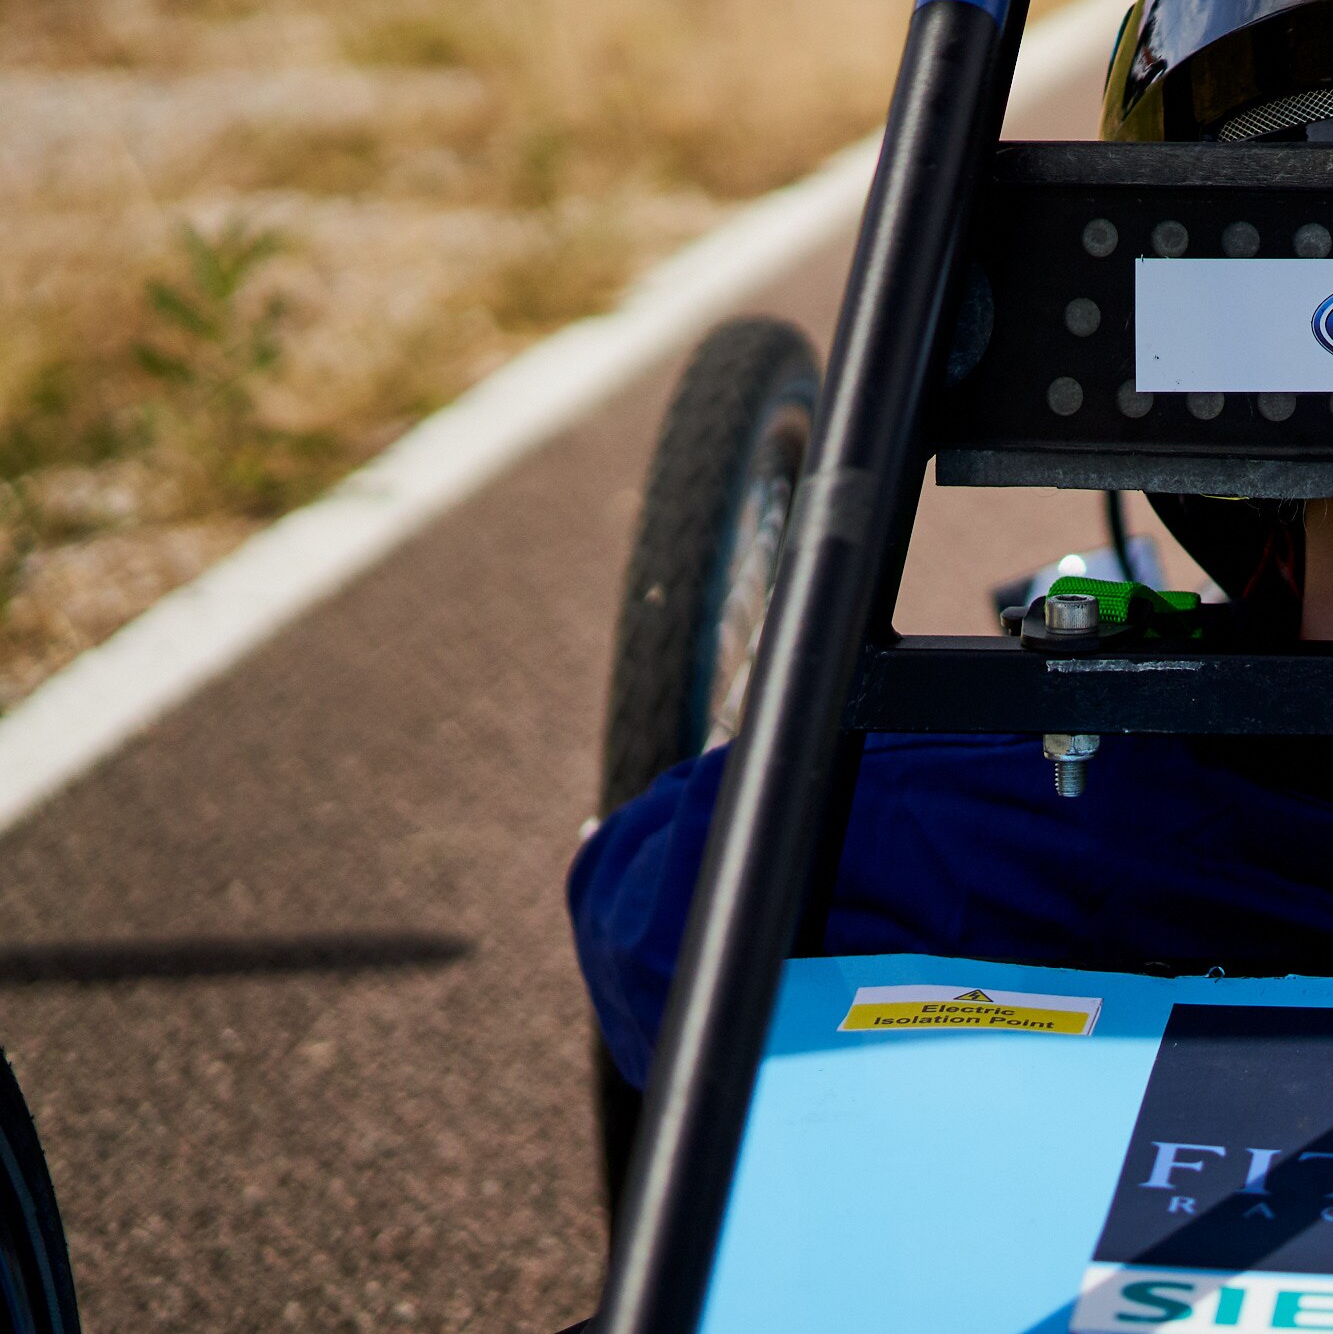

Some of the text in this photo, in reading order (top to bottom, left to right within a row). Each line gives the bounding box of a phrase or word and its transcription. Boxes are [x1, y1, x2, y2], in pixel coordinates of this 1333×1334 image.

[922, 1004, 1016, 1016] Electric
[874, 1016, 1055, 1029] Isolation Point
